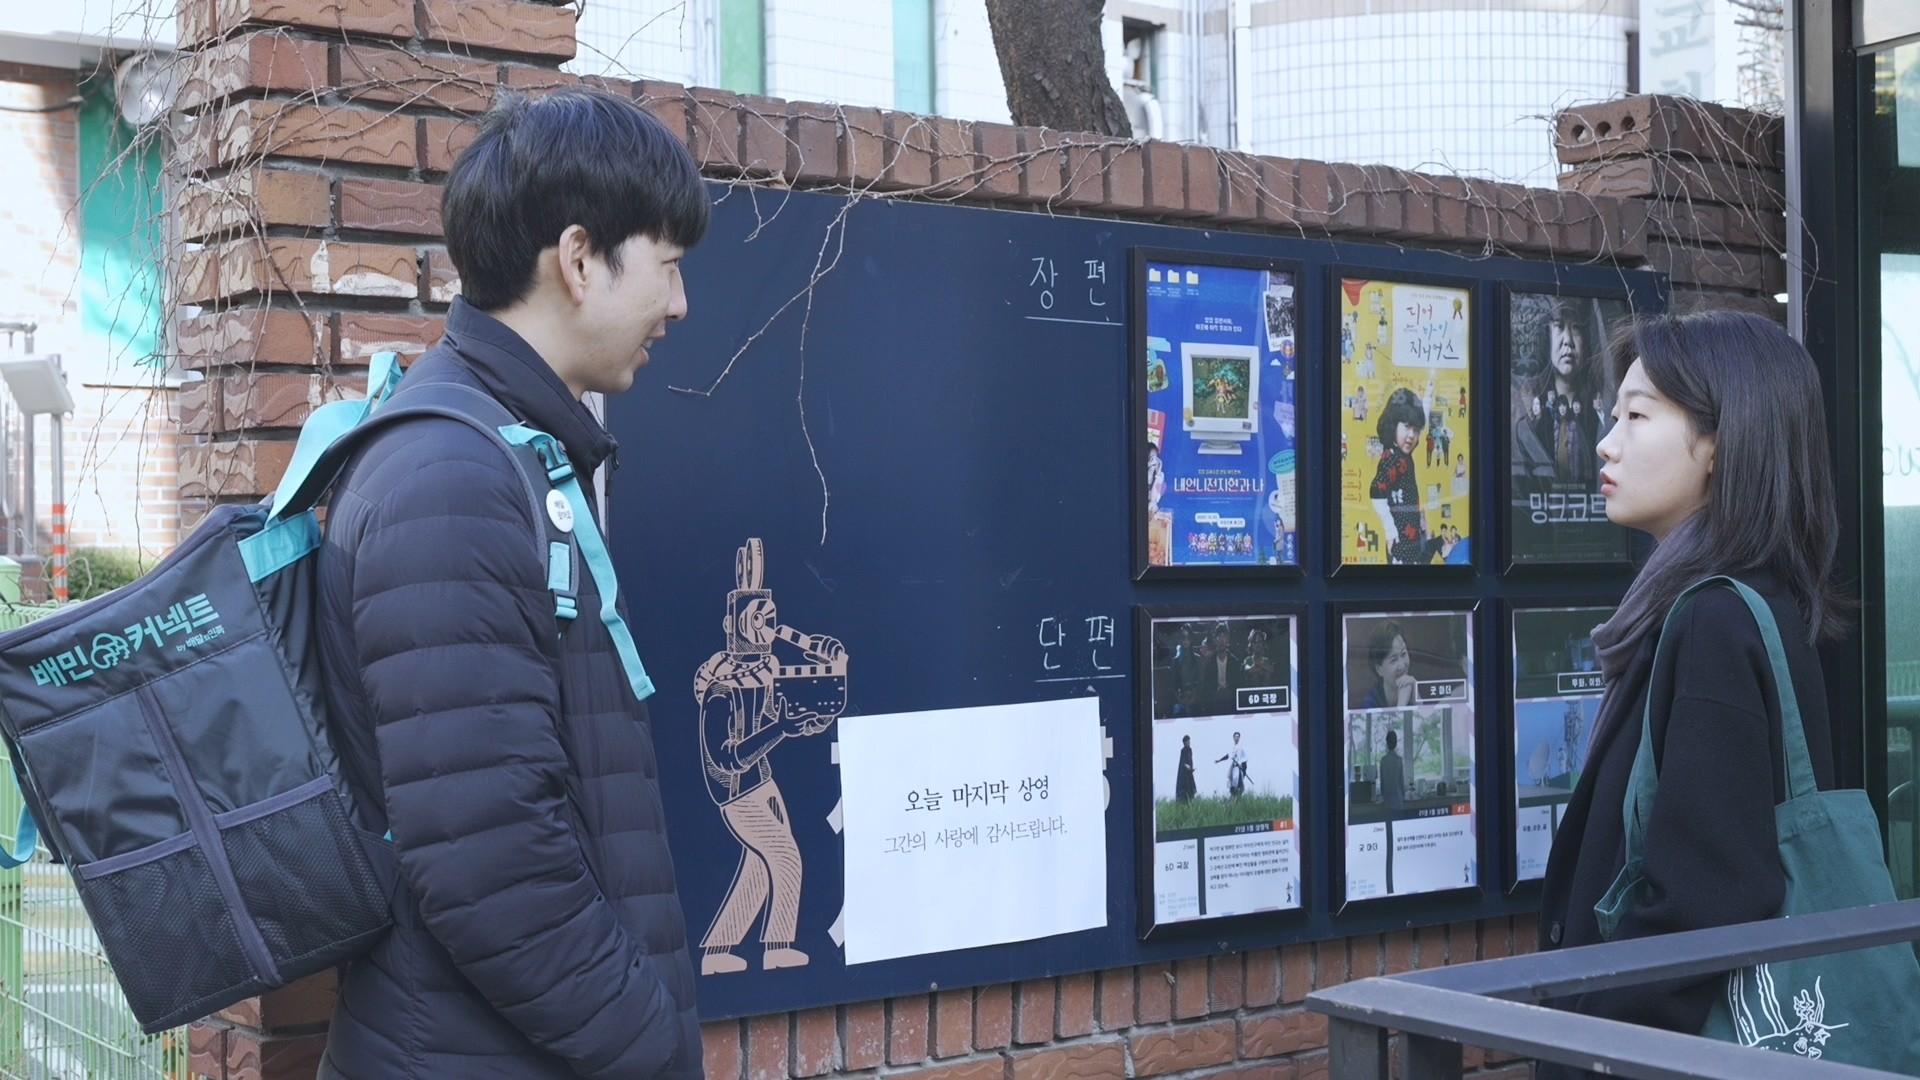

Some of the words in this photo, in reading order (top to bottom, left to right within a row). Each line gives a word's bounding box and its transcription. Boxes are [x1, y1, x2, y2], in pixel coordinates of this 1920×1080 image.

[1405, 303, 1434, 325] 디어
[1409, 337, 1460, 361] 지니어스
[1252, 477, 1265, 493] 나
[1529, 492, 1609, 524] 밍크코트
[175, 643, 186, 652] by
[1248, 694, 1260, 704] 6D
[1262, 693, 1278, 704] 극장
[904, 788, 943, 812] 오늘
[952, 779, 1010, 808] 마지막
[1017, 774, 1050, 800] 상영
[883, 831, 927, 855] 그간의
[934, 826, 979, 850] 사랑에
[985, 815, 1069, 844] 감사드립니다.
[1165, 863, 1174, 872] 6D
